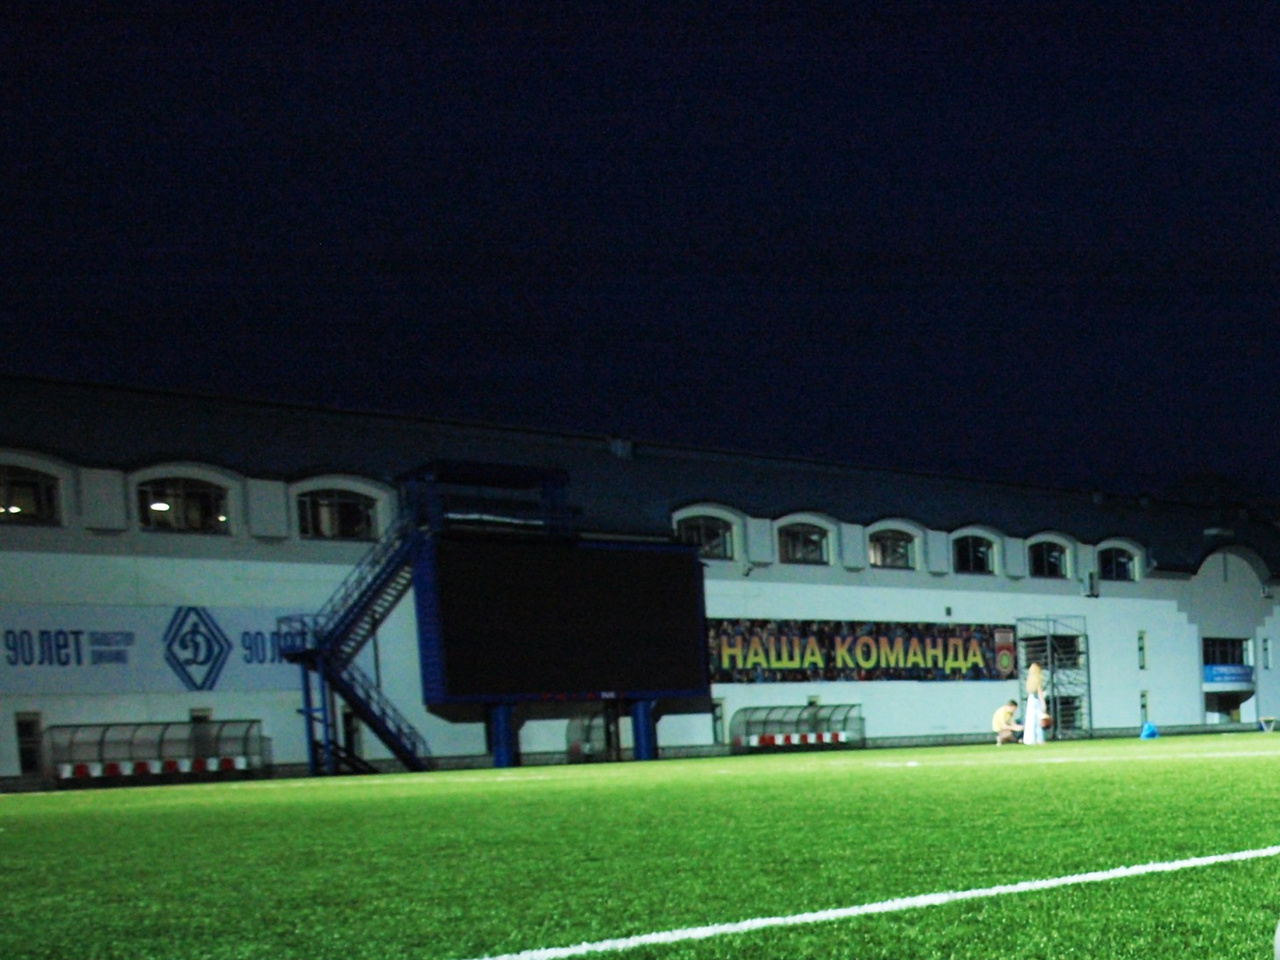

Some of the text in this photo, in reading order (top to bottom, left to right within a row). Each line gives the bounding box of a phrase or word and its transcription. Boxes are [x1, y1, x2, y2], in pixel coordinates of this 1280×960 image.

[4, 629, 34, 666] 90
[241, 631, 267, 664] 90
[720, 635, 986, 674] НАША КОМАНДА
